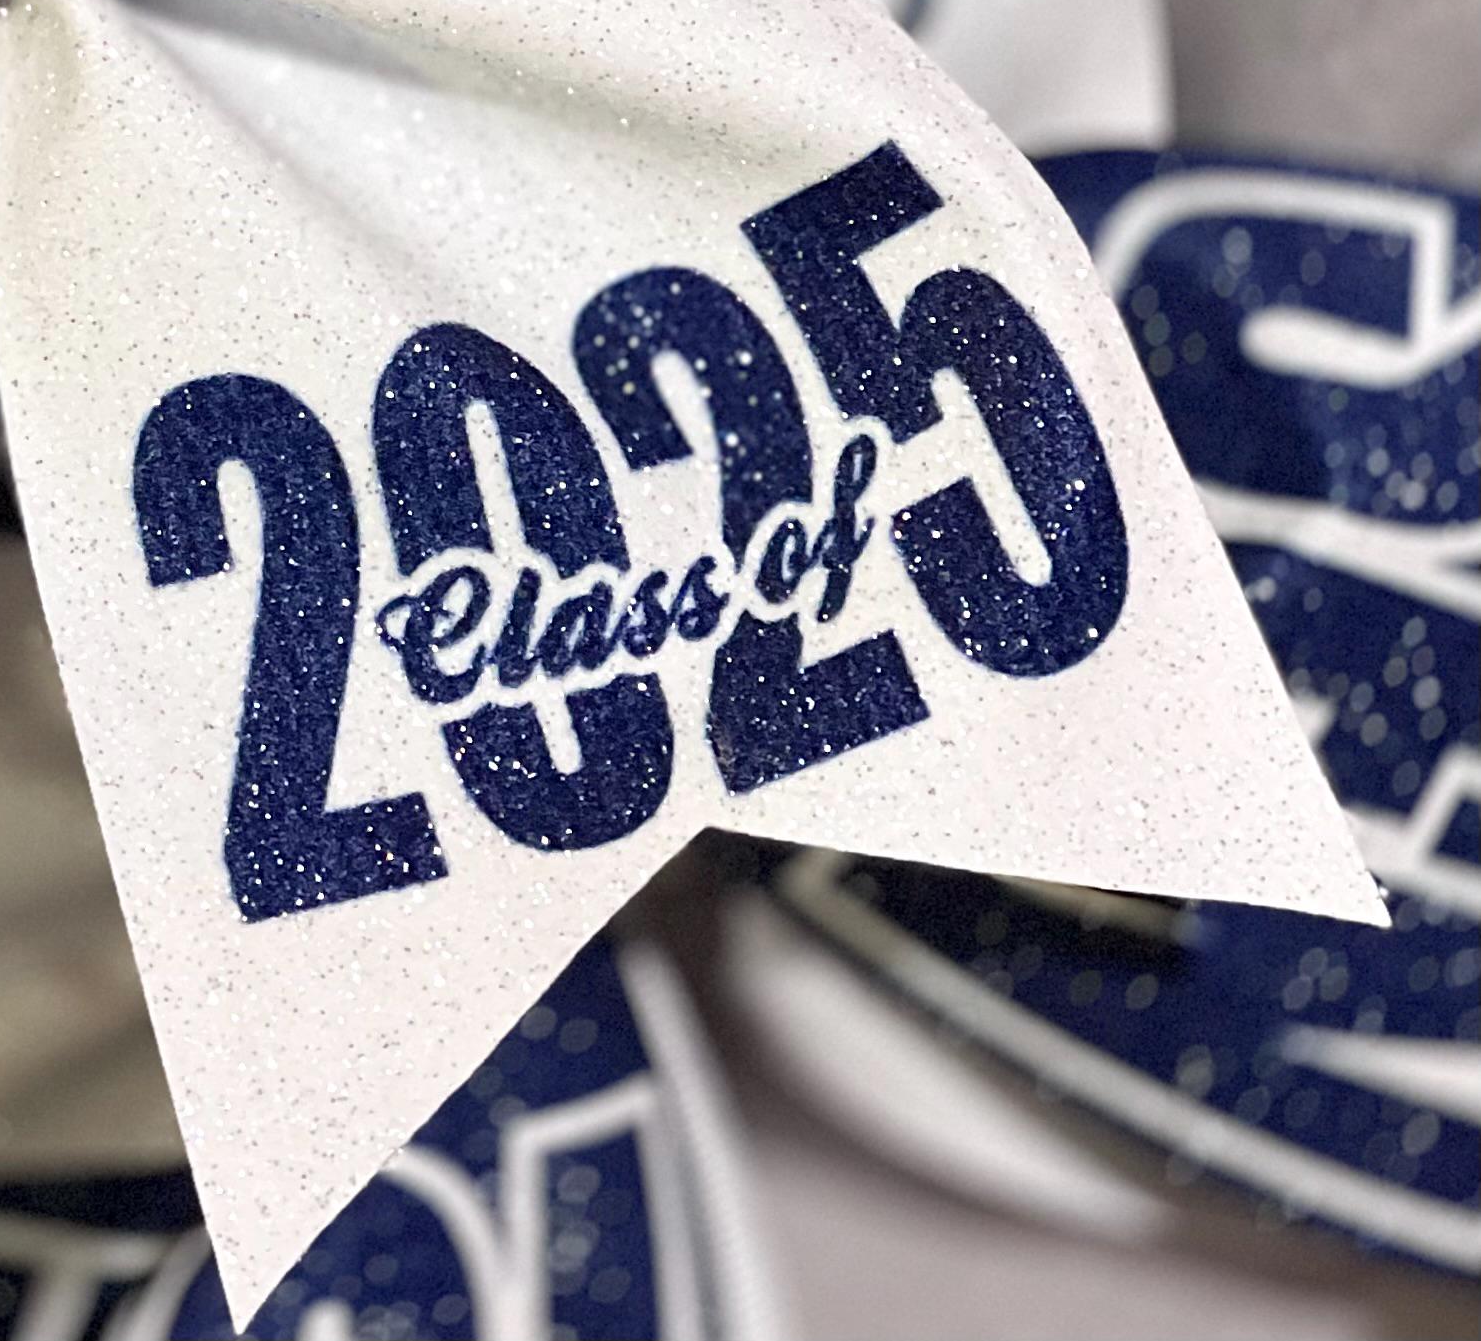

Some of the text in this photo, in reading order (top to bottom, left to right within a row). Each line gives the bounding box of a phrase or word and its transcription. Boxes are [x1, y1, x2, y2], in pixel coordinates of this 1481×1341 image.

[132, 139, 1129, 923] 2025
[378, 431, 879, 704] Class of
